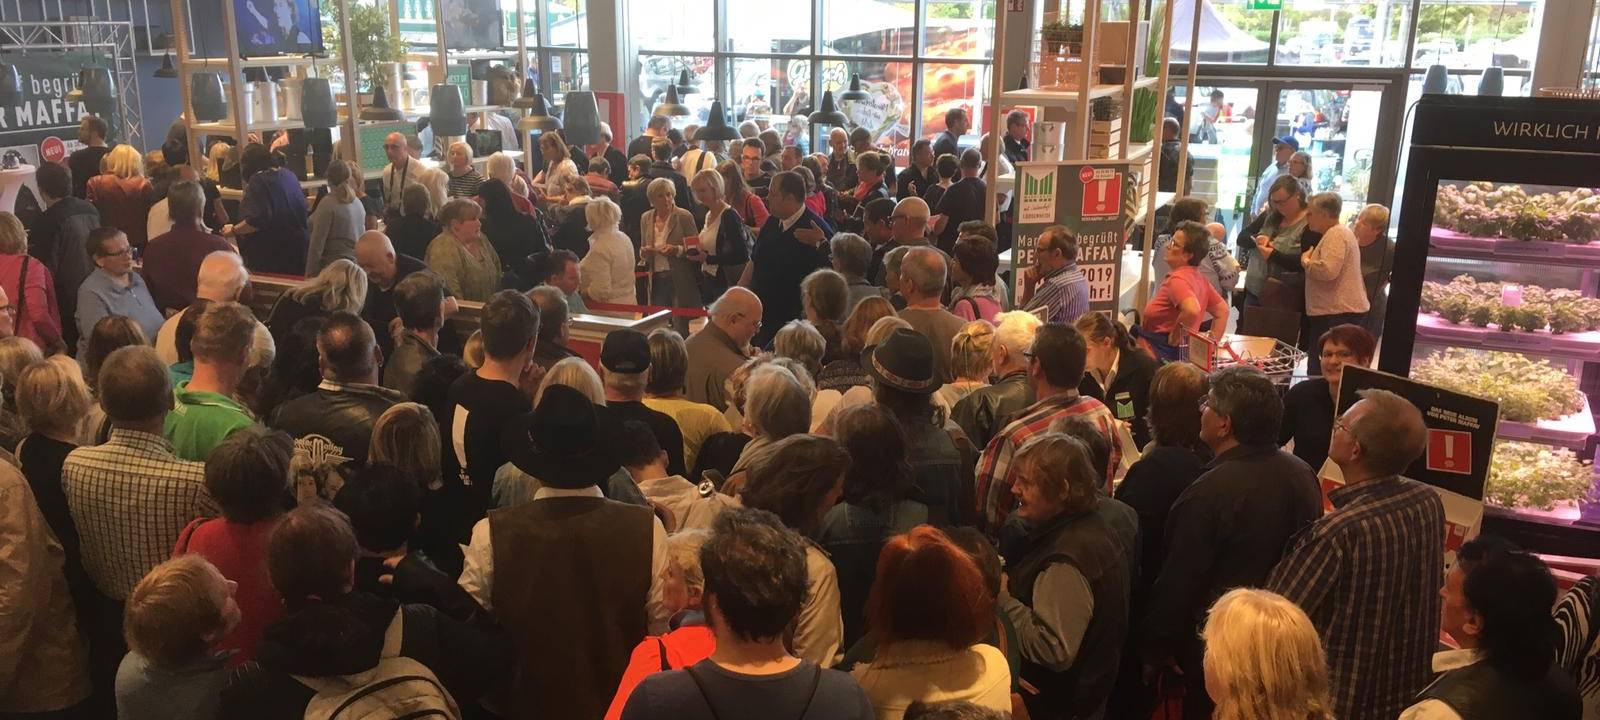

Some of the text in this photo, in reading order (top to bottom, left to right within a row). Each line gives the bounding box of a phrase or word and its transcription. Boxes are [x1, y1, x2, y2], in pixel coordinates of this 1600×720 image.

[30, 73, 82, 97] begrü
[15, 99, 89, 127] MAFFA
[1492, 121, 1589, 140] WIRKLICH
[1077, 231, 1118, 246] begrüßt
[1075, 245, 1118, 262] AFFAY
[1080, 267, 1113, 282] 2019
[1089, 285, 1111, 299] hr!
